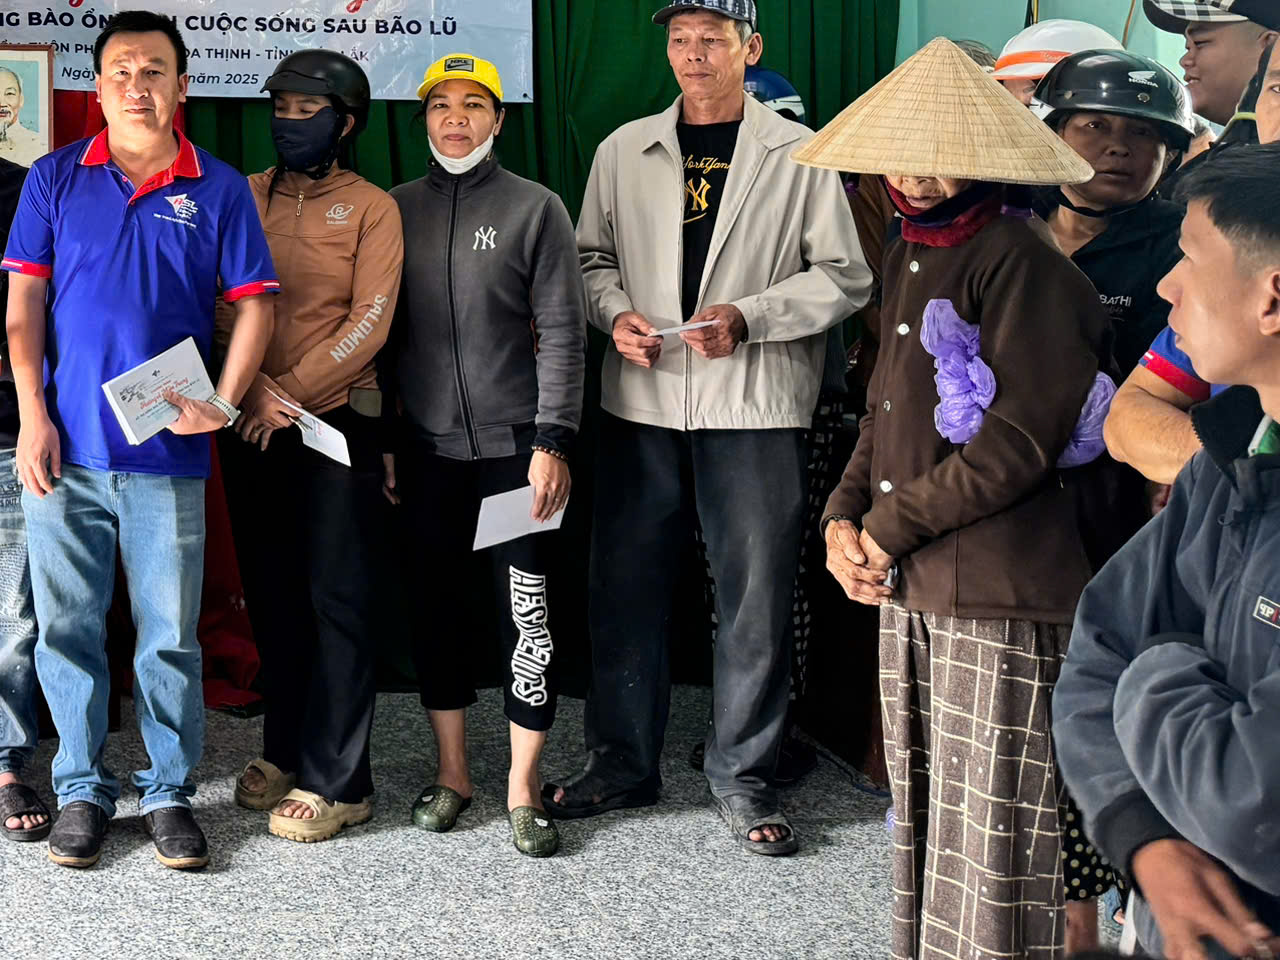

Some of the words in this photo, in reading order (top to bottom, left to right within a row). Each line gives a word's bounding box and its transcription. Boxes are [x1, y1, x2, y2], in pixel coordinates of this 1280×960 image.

[28, 7, 75, 28] BÀO
[184, 12, 248, 36] CUỘC
[254, 11, 316, 33] SỐNG
[323, 16, 367, 34] SAU
[375, 14, 422, 35] BÃO
[430, 16, 458, 36] LŨ
[204, 48, 251, 62] THỊNH
[264, 46, 294, 60] TỈN
[340, 46, 370, 61] ẮK
[224, 73, 259, 85] 2025
[1128, 77, 1159, 88] HONDA
[472, 225, 498, 251] NY
[329, 293, 389, 364] SALOMON
